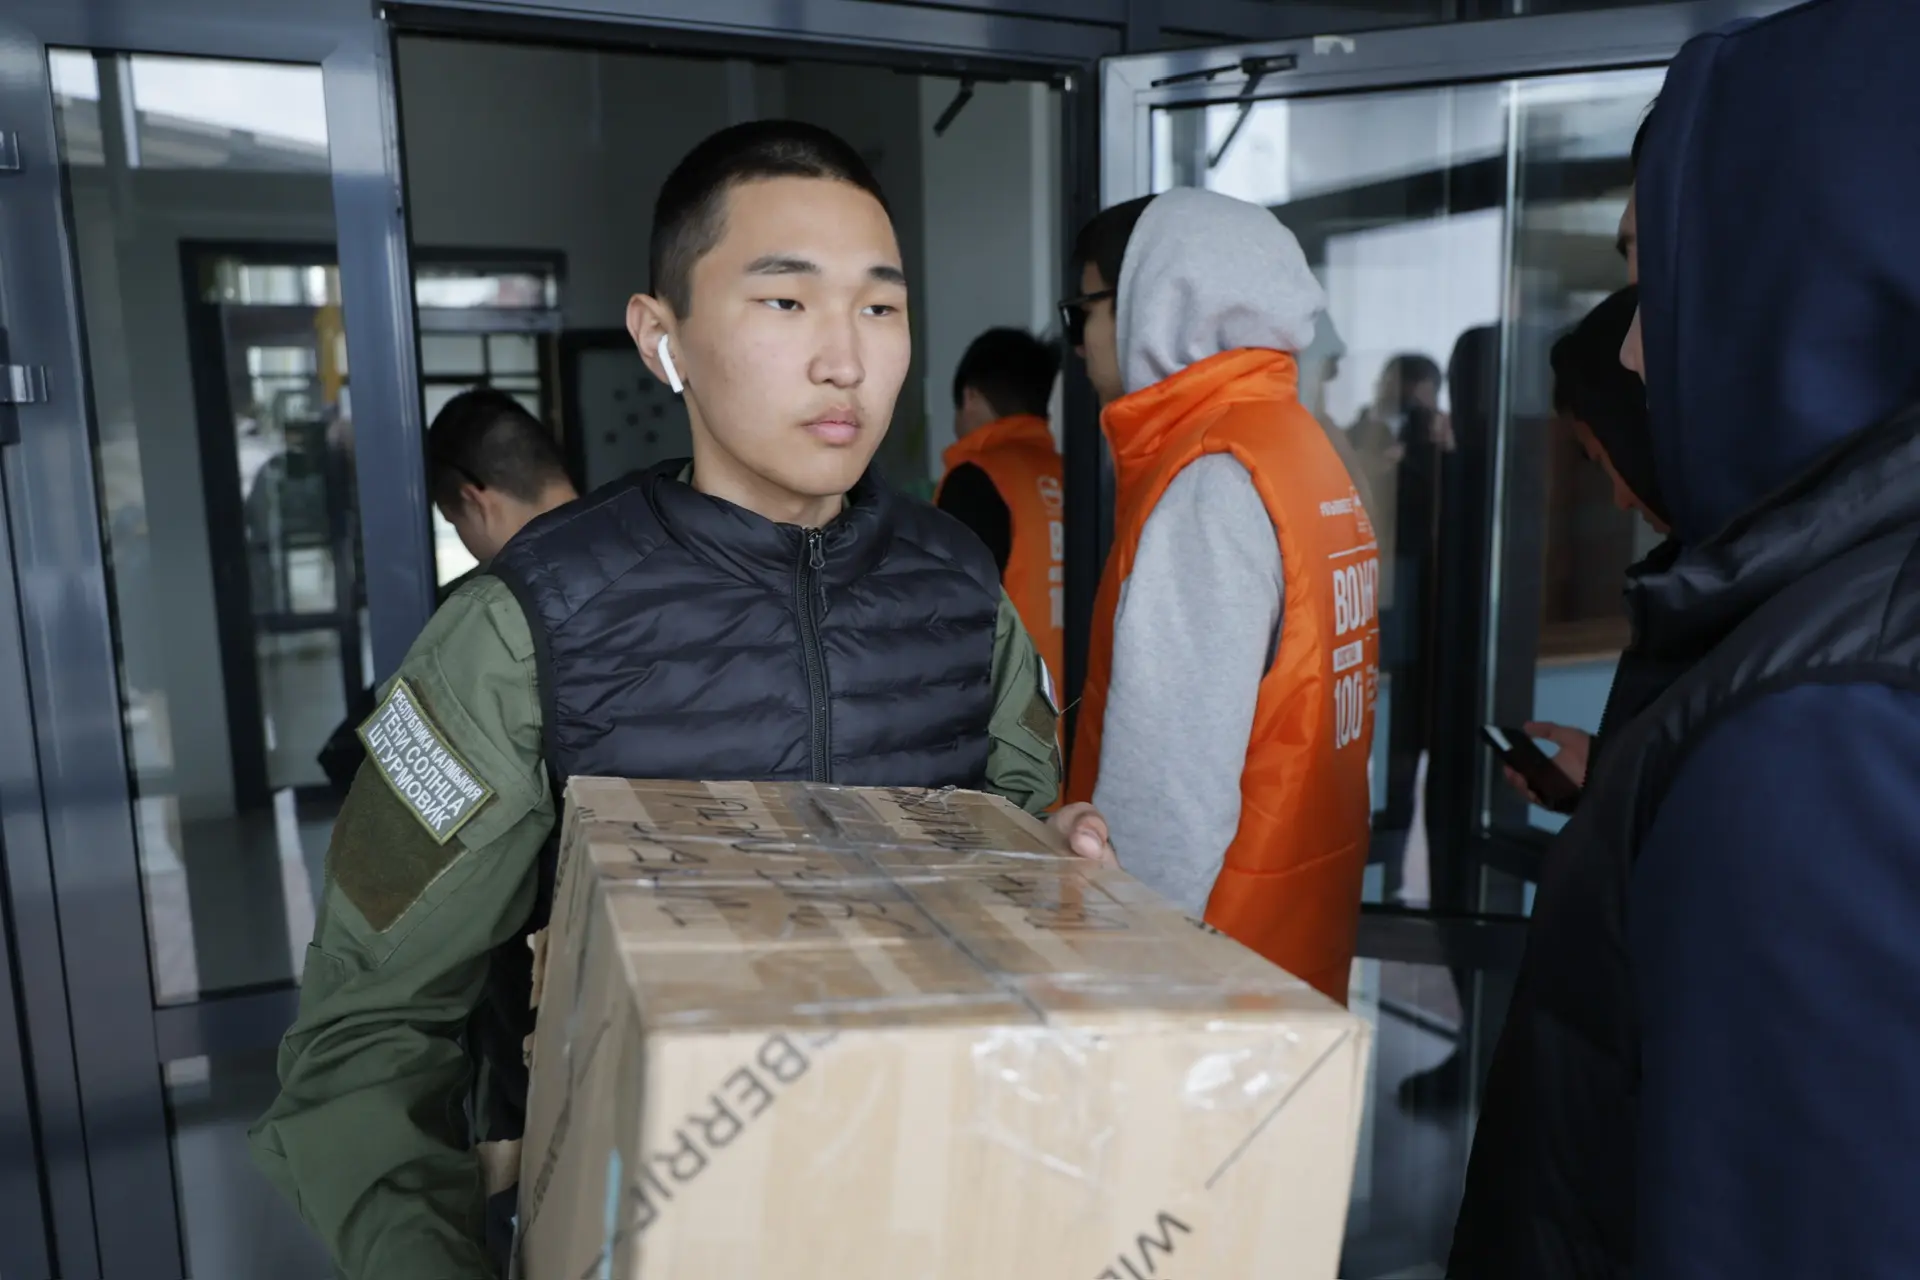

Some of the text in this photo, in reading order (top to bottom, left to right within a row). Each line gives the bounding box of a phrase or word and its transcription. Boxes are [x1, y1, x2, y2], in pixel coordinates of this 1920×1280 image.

[367, 723, 452, 831] ШТУРМОВИК
[380, 702, 466, 817] ТЕНИ СОЛНЦА
[391, 687, 484, 802] РЕСПУБЛИКА КАЛМЫКИЯ
[628, 1029, 838, 1239] BERRI
